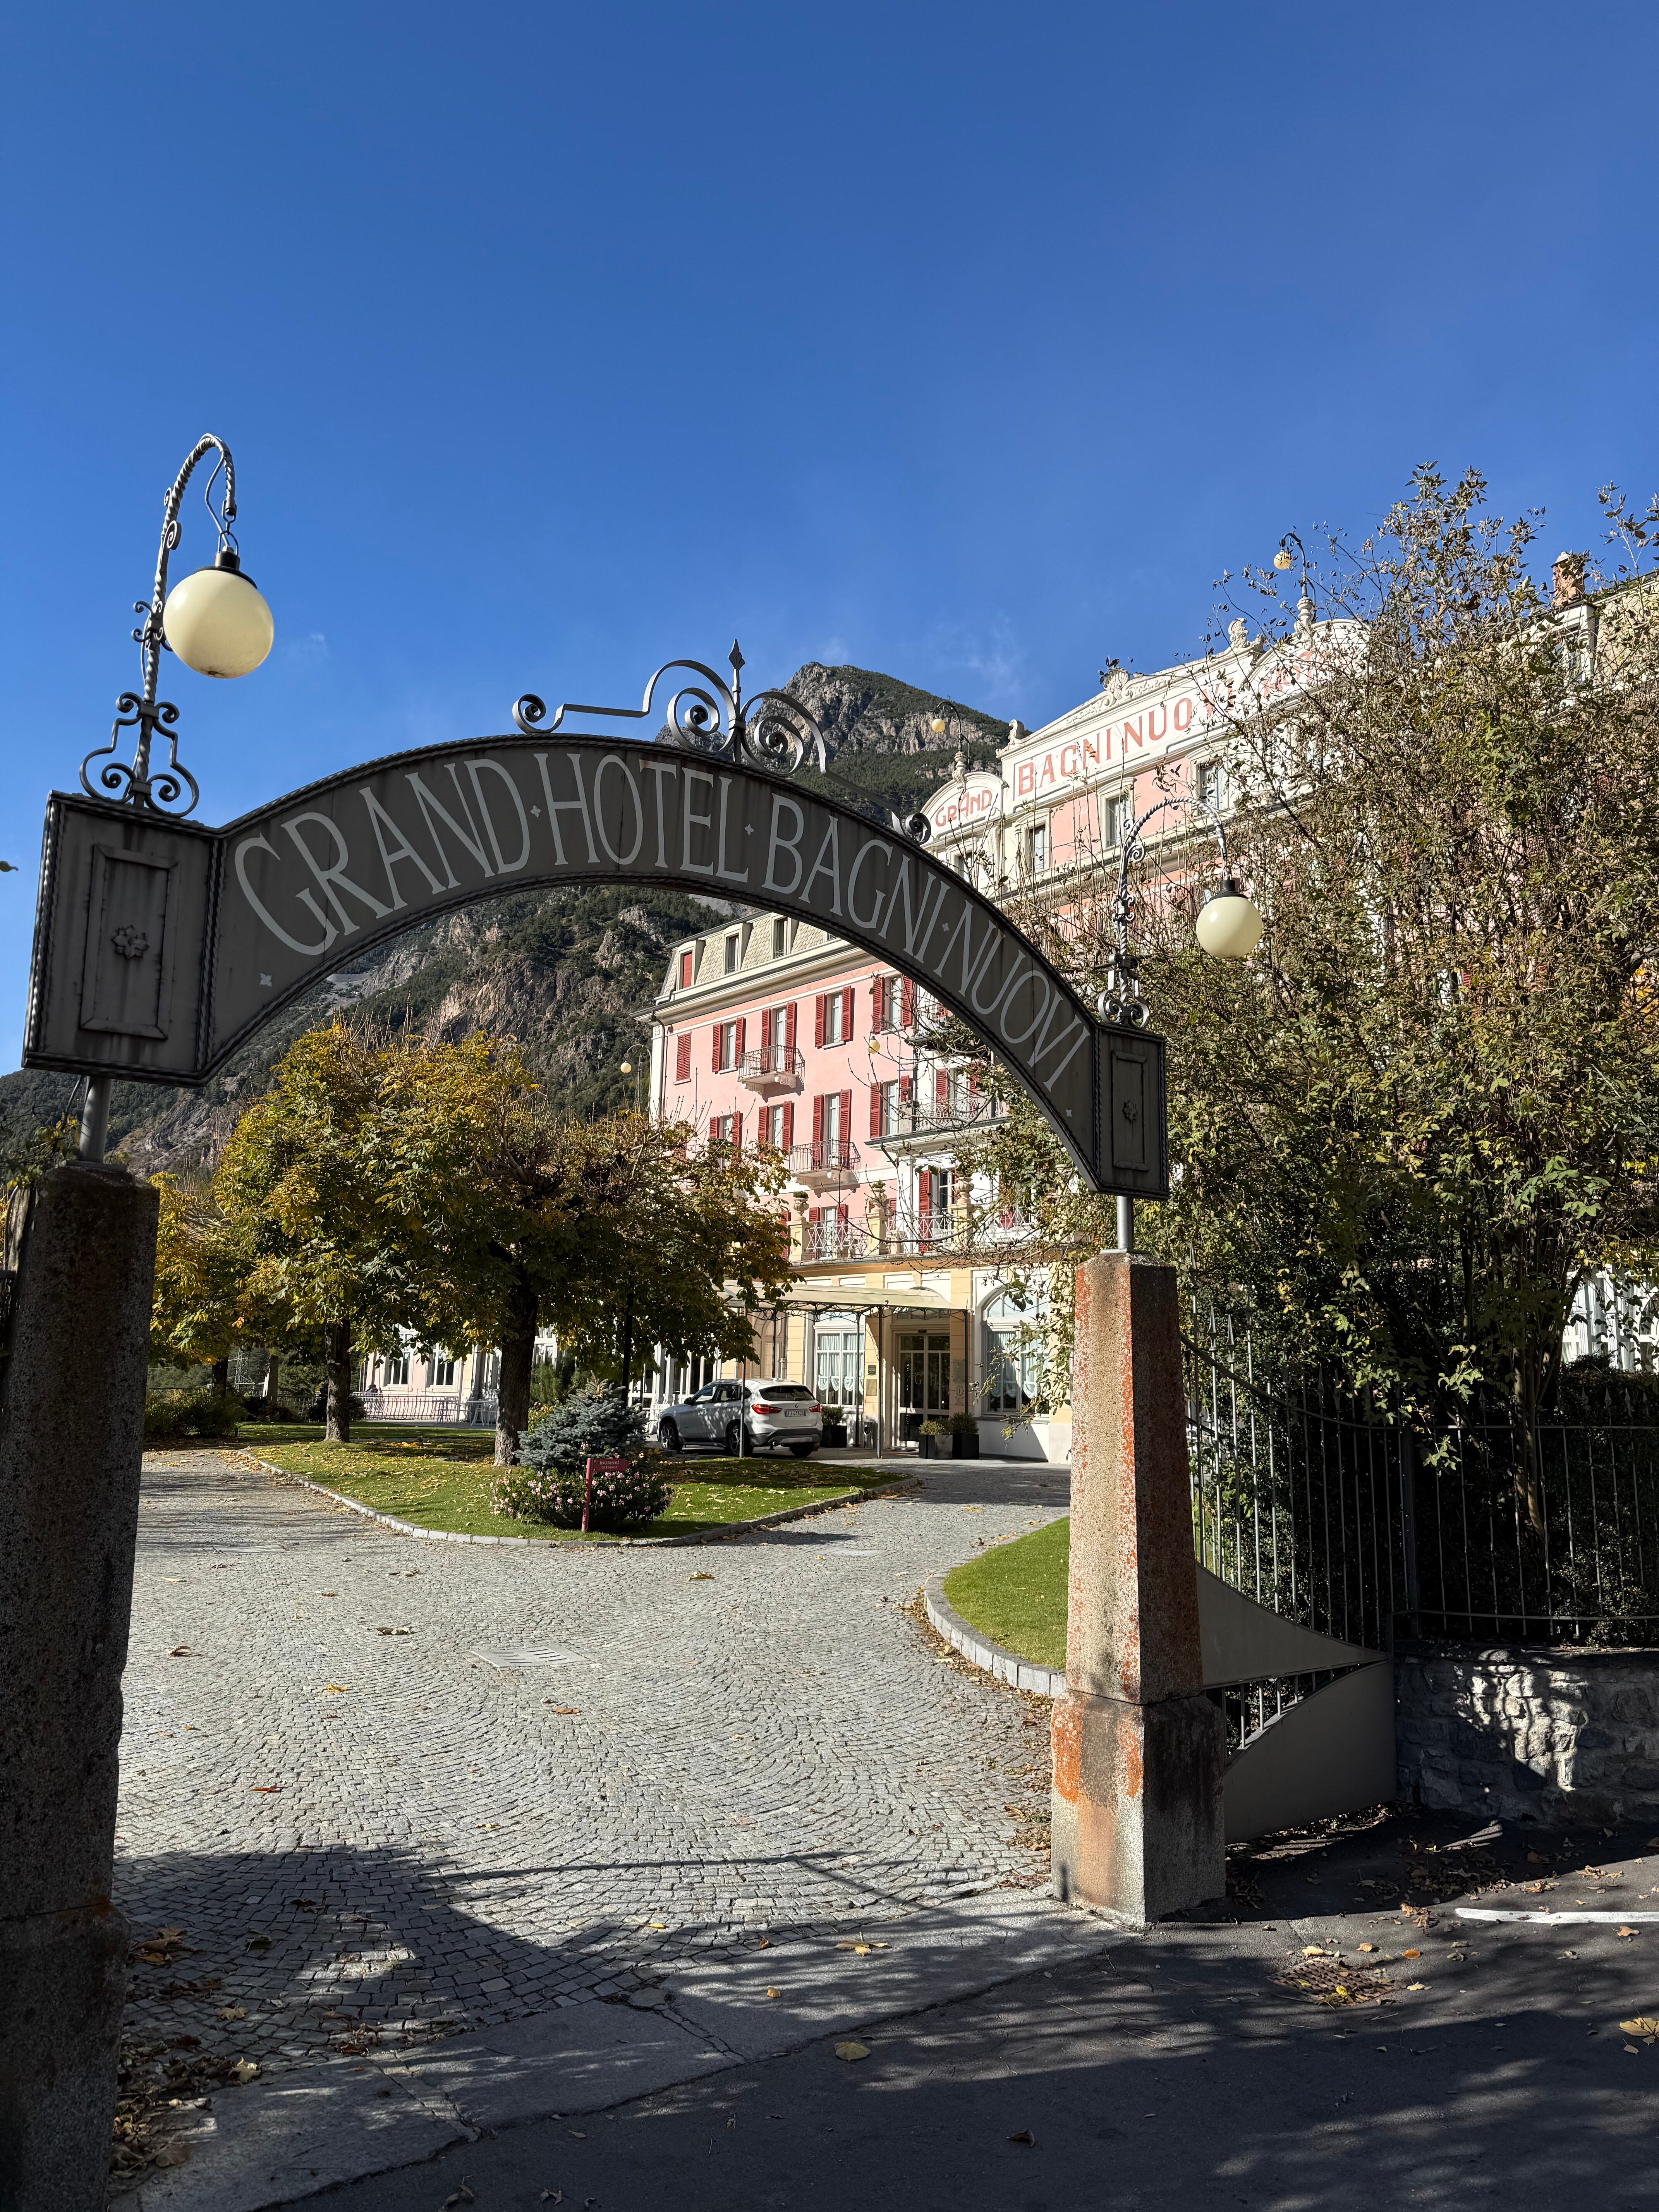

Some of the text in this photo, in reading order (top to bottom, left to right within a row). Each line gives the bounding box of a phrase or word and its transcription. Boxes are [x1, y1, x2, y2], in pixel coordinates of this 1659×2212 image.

[1018, 727, 1112, 797] BAGNI
[935, 790, 992, 827] GRAND
[235, 753, 1091, 1092] GRAND HOTEL BAGNI NUOVI
